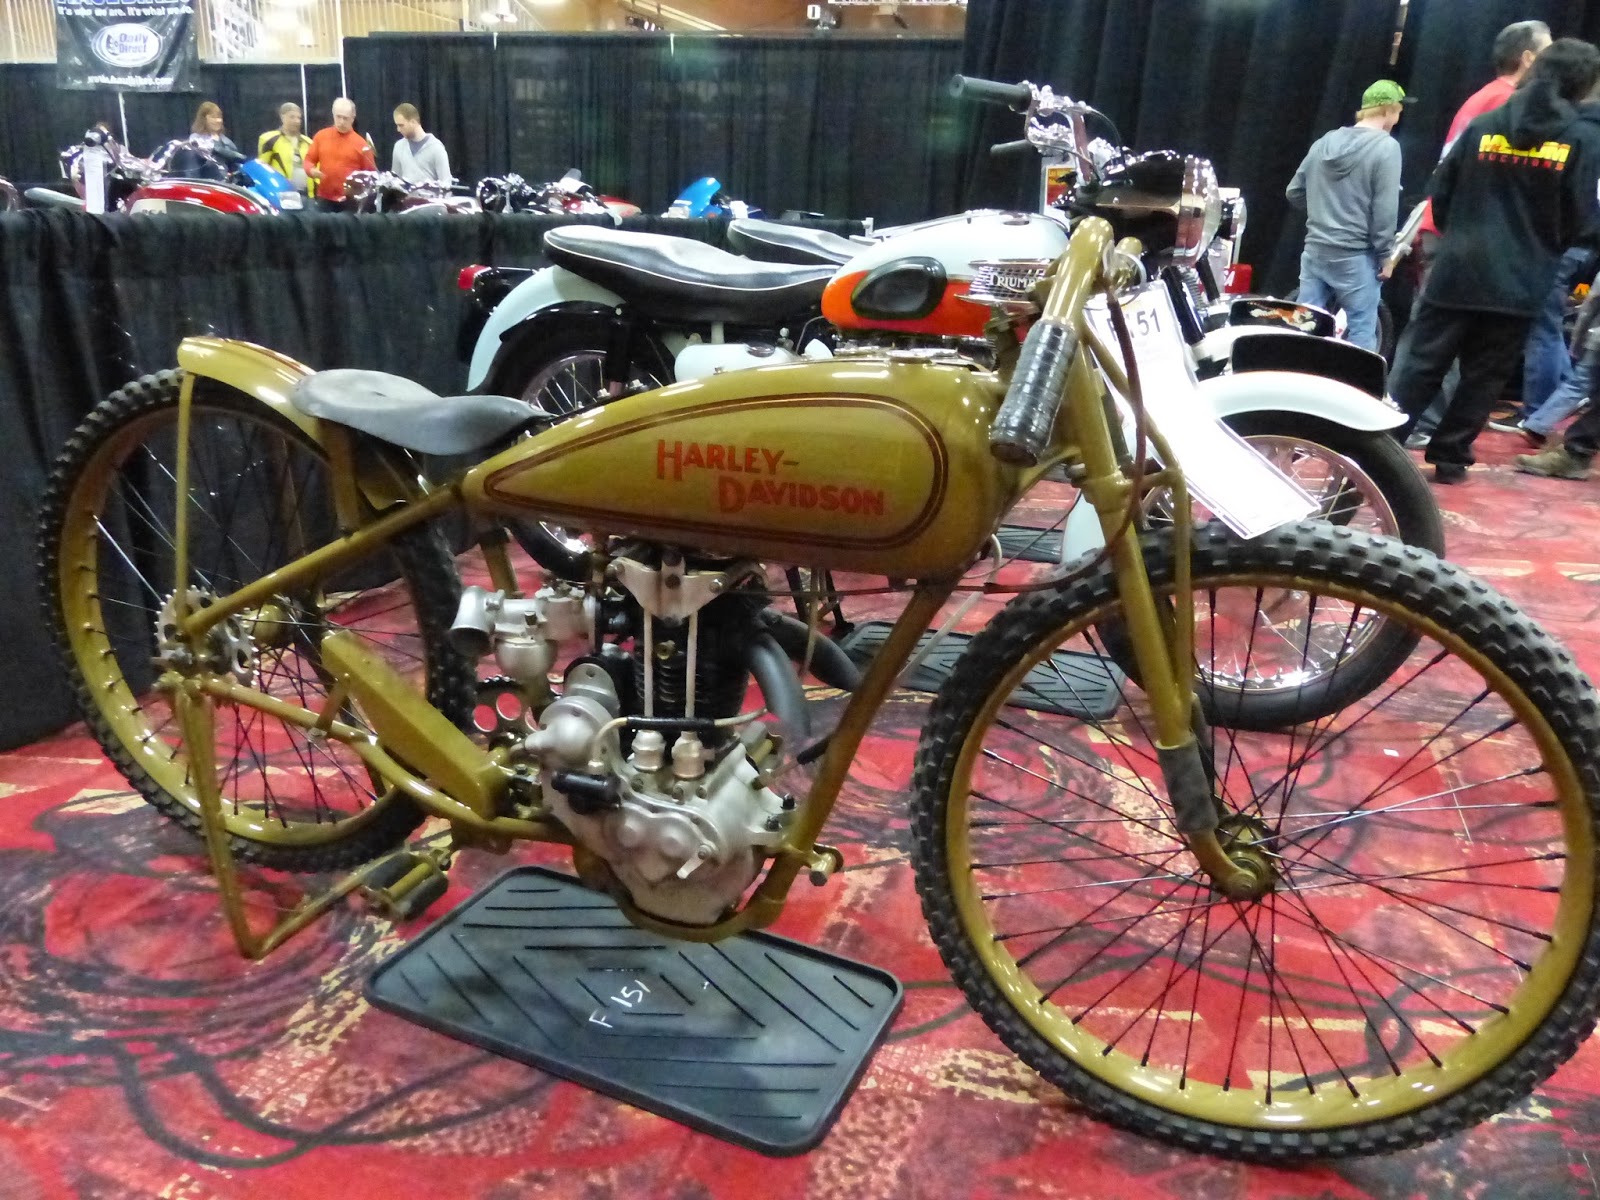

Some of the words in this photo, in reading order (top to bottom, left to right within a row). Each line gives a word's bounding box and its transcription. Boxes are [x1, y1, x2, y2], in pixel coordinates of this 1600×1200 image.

[656, 439, 799, 482] HARLEY-
[718, 475, 884, 516] DAVIDSON
[610, 979, 651, 1008] 151
